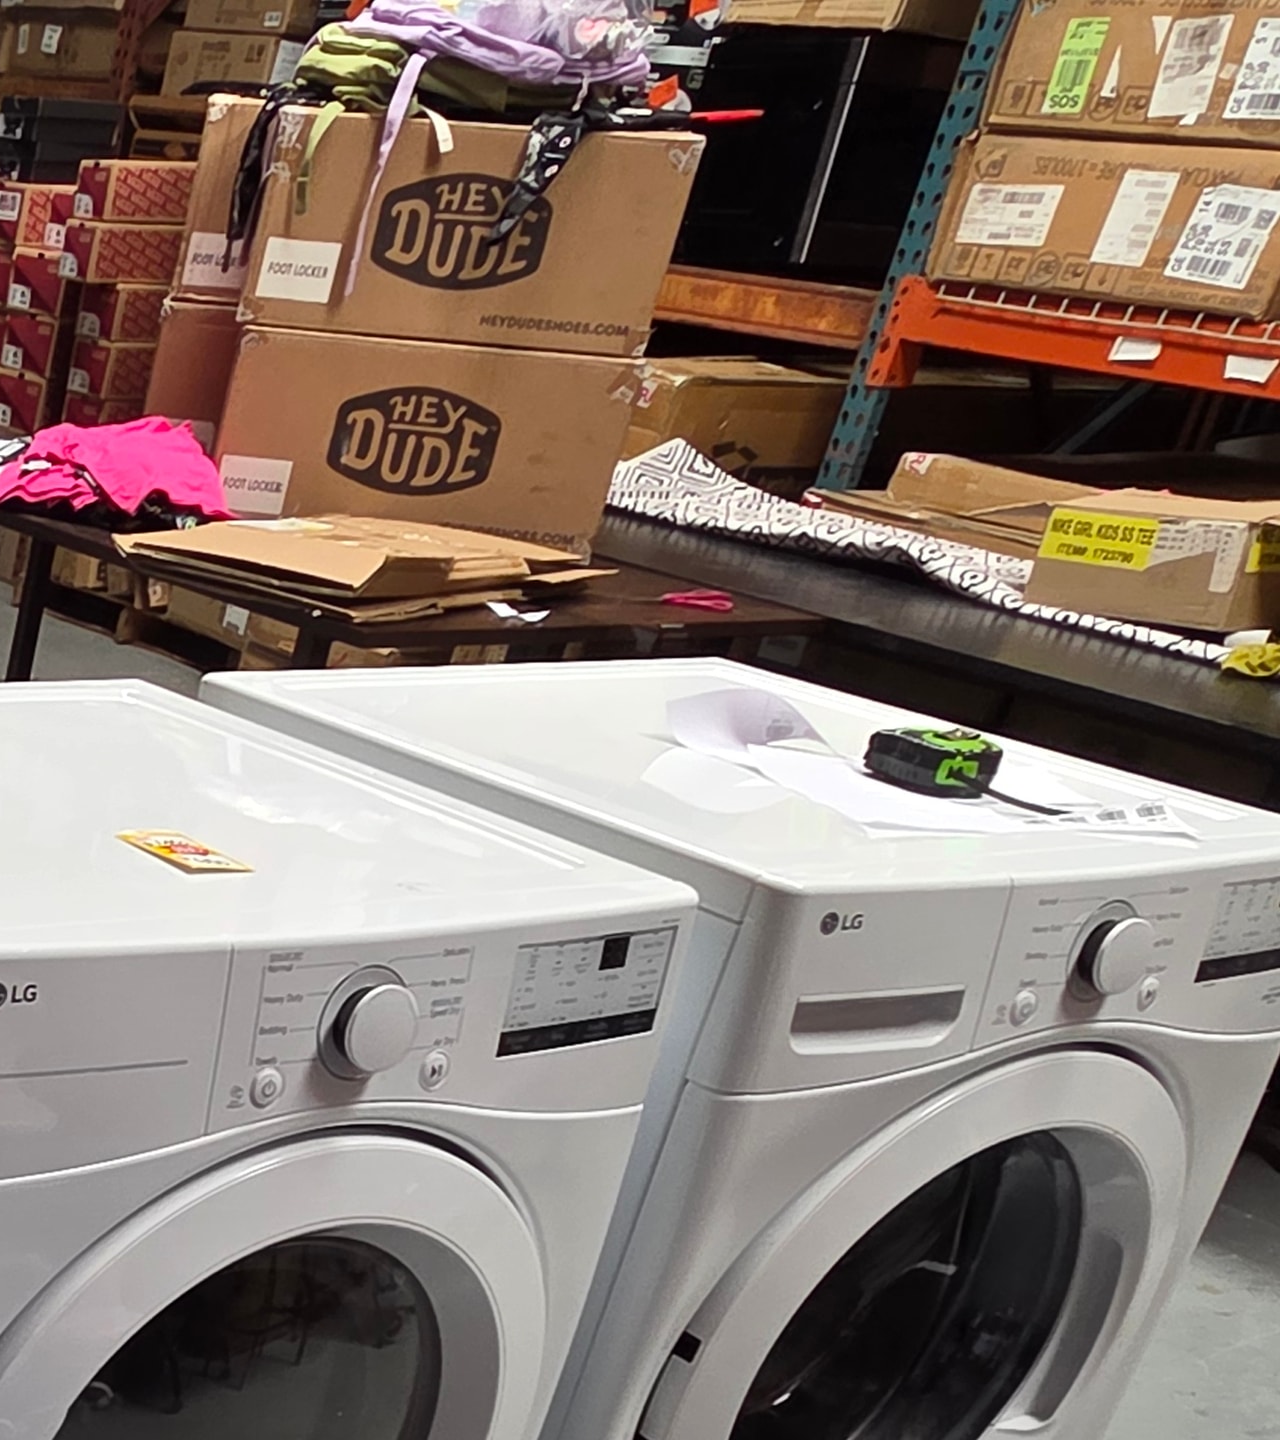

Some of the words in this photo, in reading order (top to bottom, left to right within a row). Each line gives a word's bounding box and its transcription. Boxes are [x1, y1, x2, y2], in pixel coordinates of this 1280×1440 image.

[1049, 95, 1081, 109] SOS
[385, 198, 547, 281] DUDE
[267, 261, 293, 275] FOOT
[293, 263, 329, 278] LOCKER
[479, 314, 630, 337] HEYDUDESHOES.COM
[390, 395, 467, 431] HEY
[340, 408, 488, 487] DUDE
[223, 475, 245, 490] FOOT
[841, 914, 865, 931] LG
[10, 984, 38, 1003] LG
